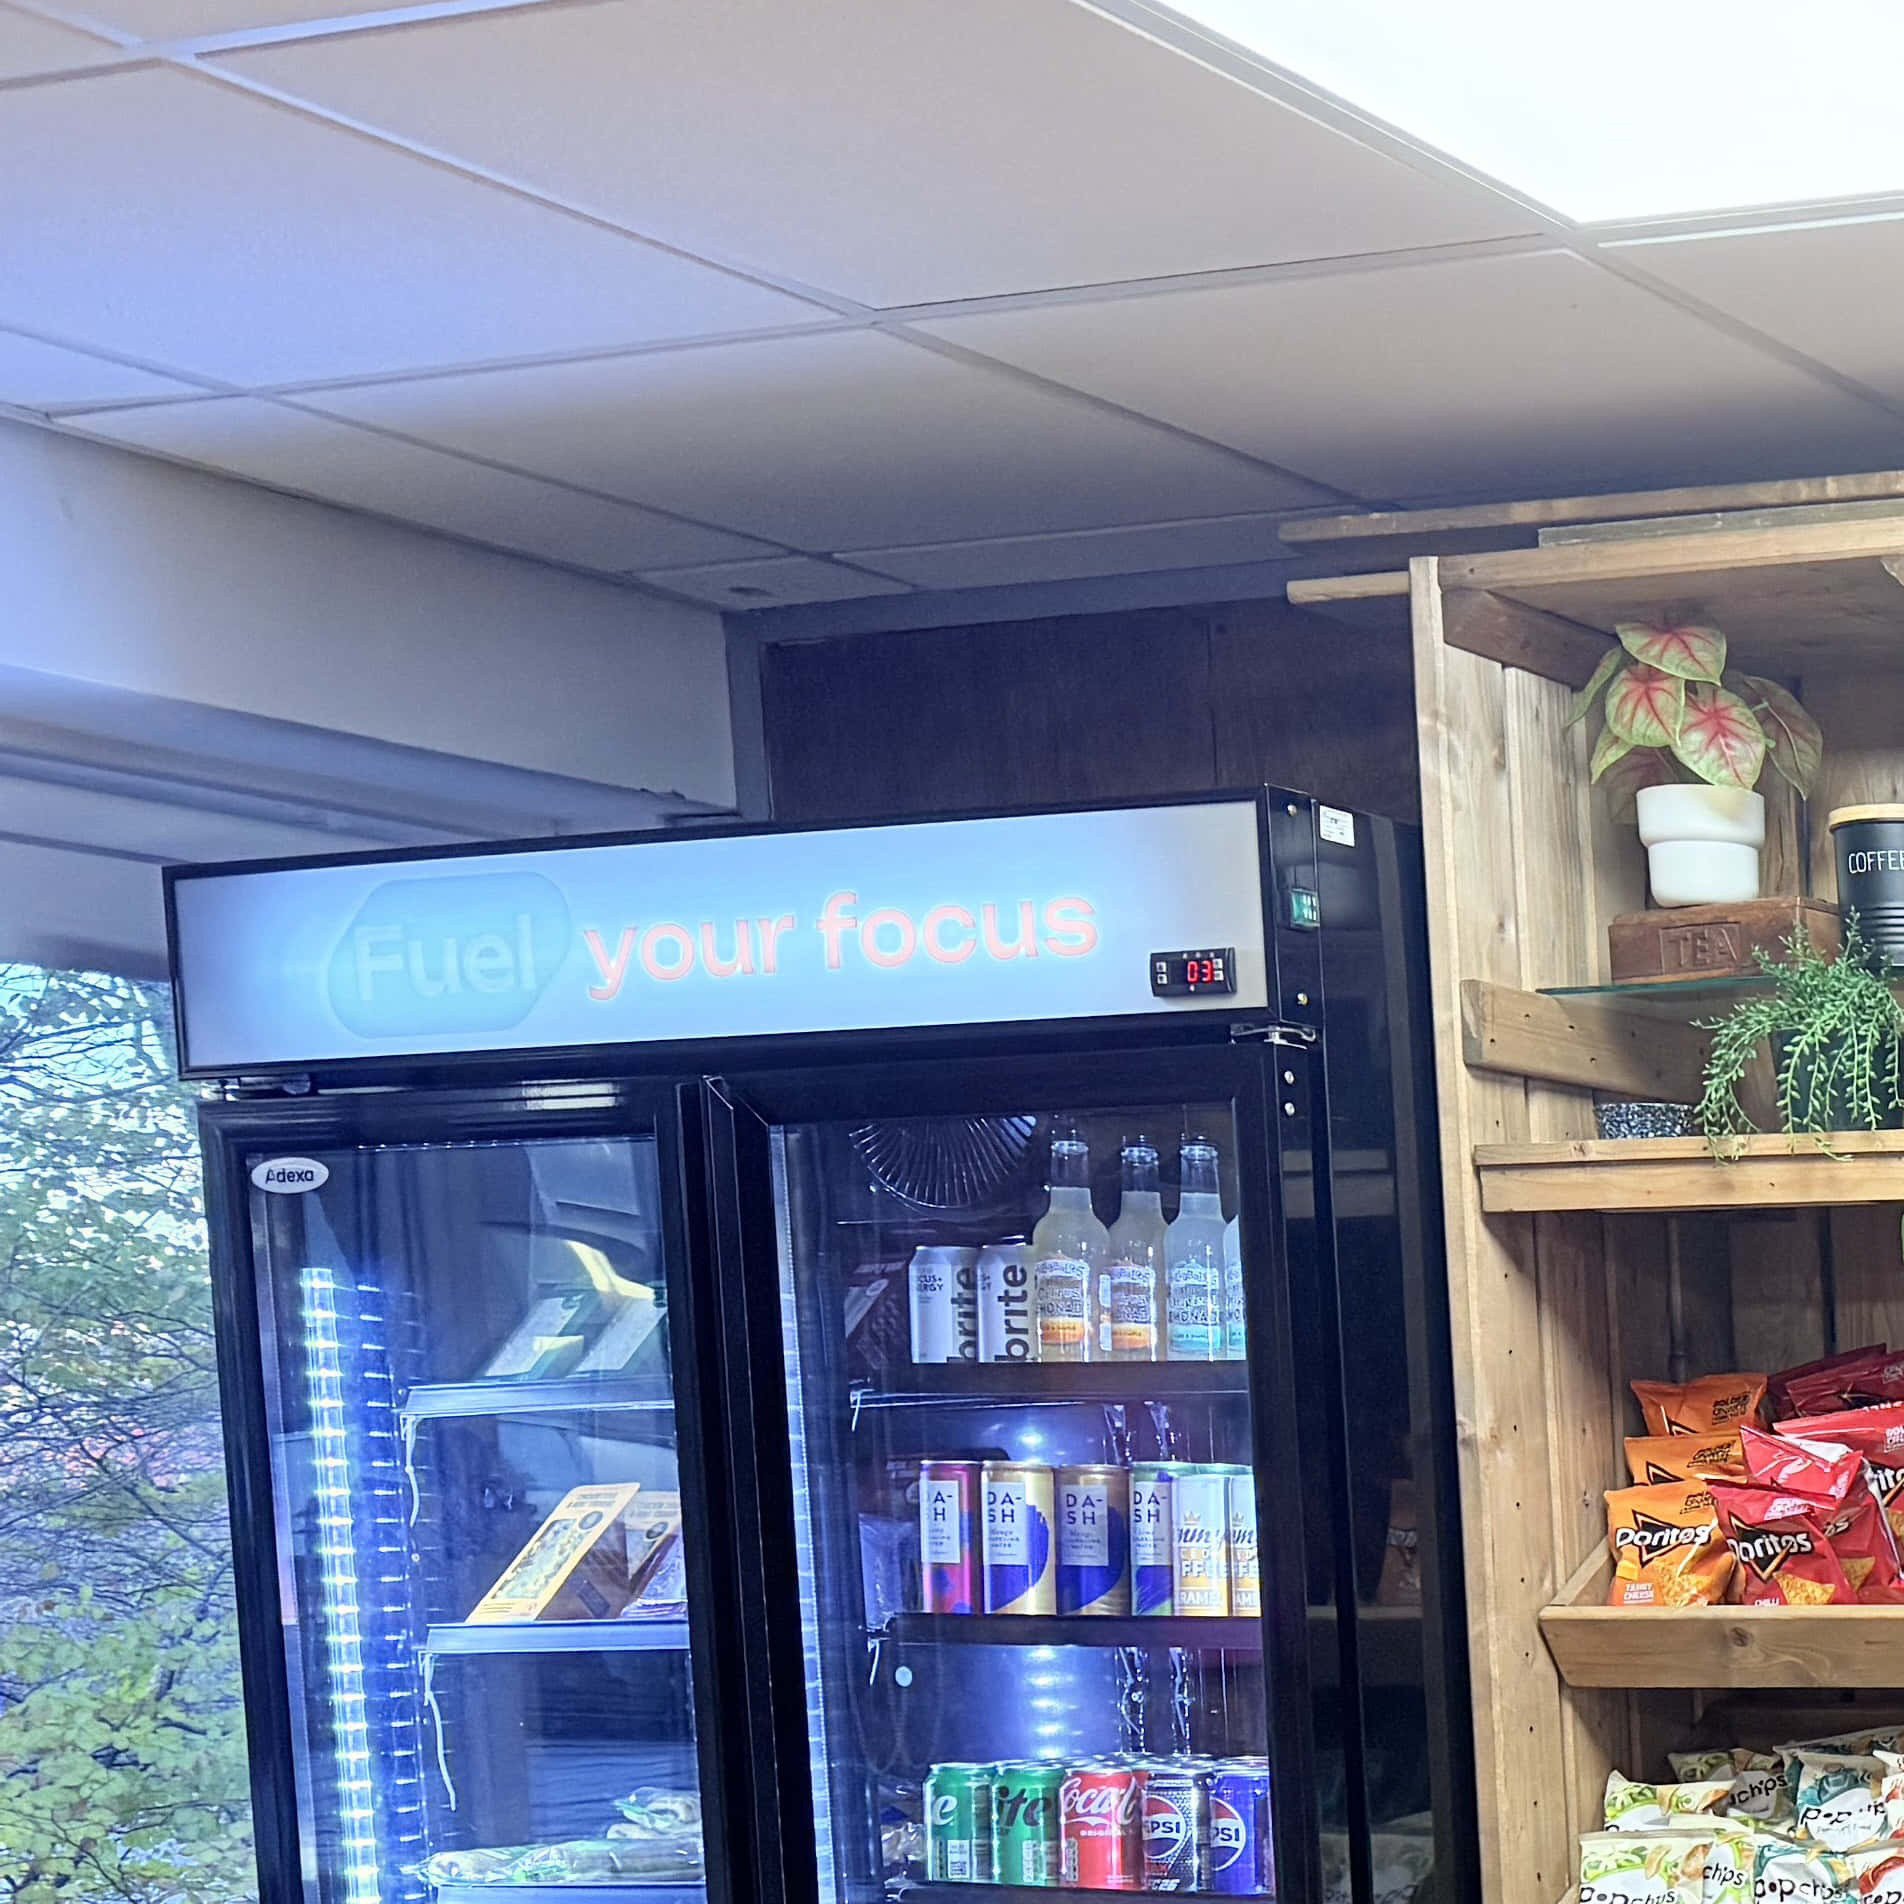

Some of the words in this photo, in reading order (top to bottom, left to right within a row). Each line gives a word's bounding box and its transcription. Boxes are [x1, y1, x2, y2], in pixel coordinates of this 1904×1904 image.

[354, 914, 538, 1000] Fuel
[583, 913, 797, 1001] your
[815, 890, 1100, 970] focus
[264, 1166, 315, 1186] Adexa
[1066, 1493, 1104, 1508] DA-
[1067, 1511, 1097, 1525] SH
[1616, 1525, 1711, 1547] Doritos
[1729, 1773, 1789, 1805] chips
[1703, 1864, 1745, 1887] chips
